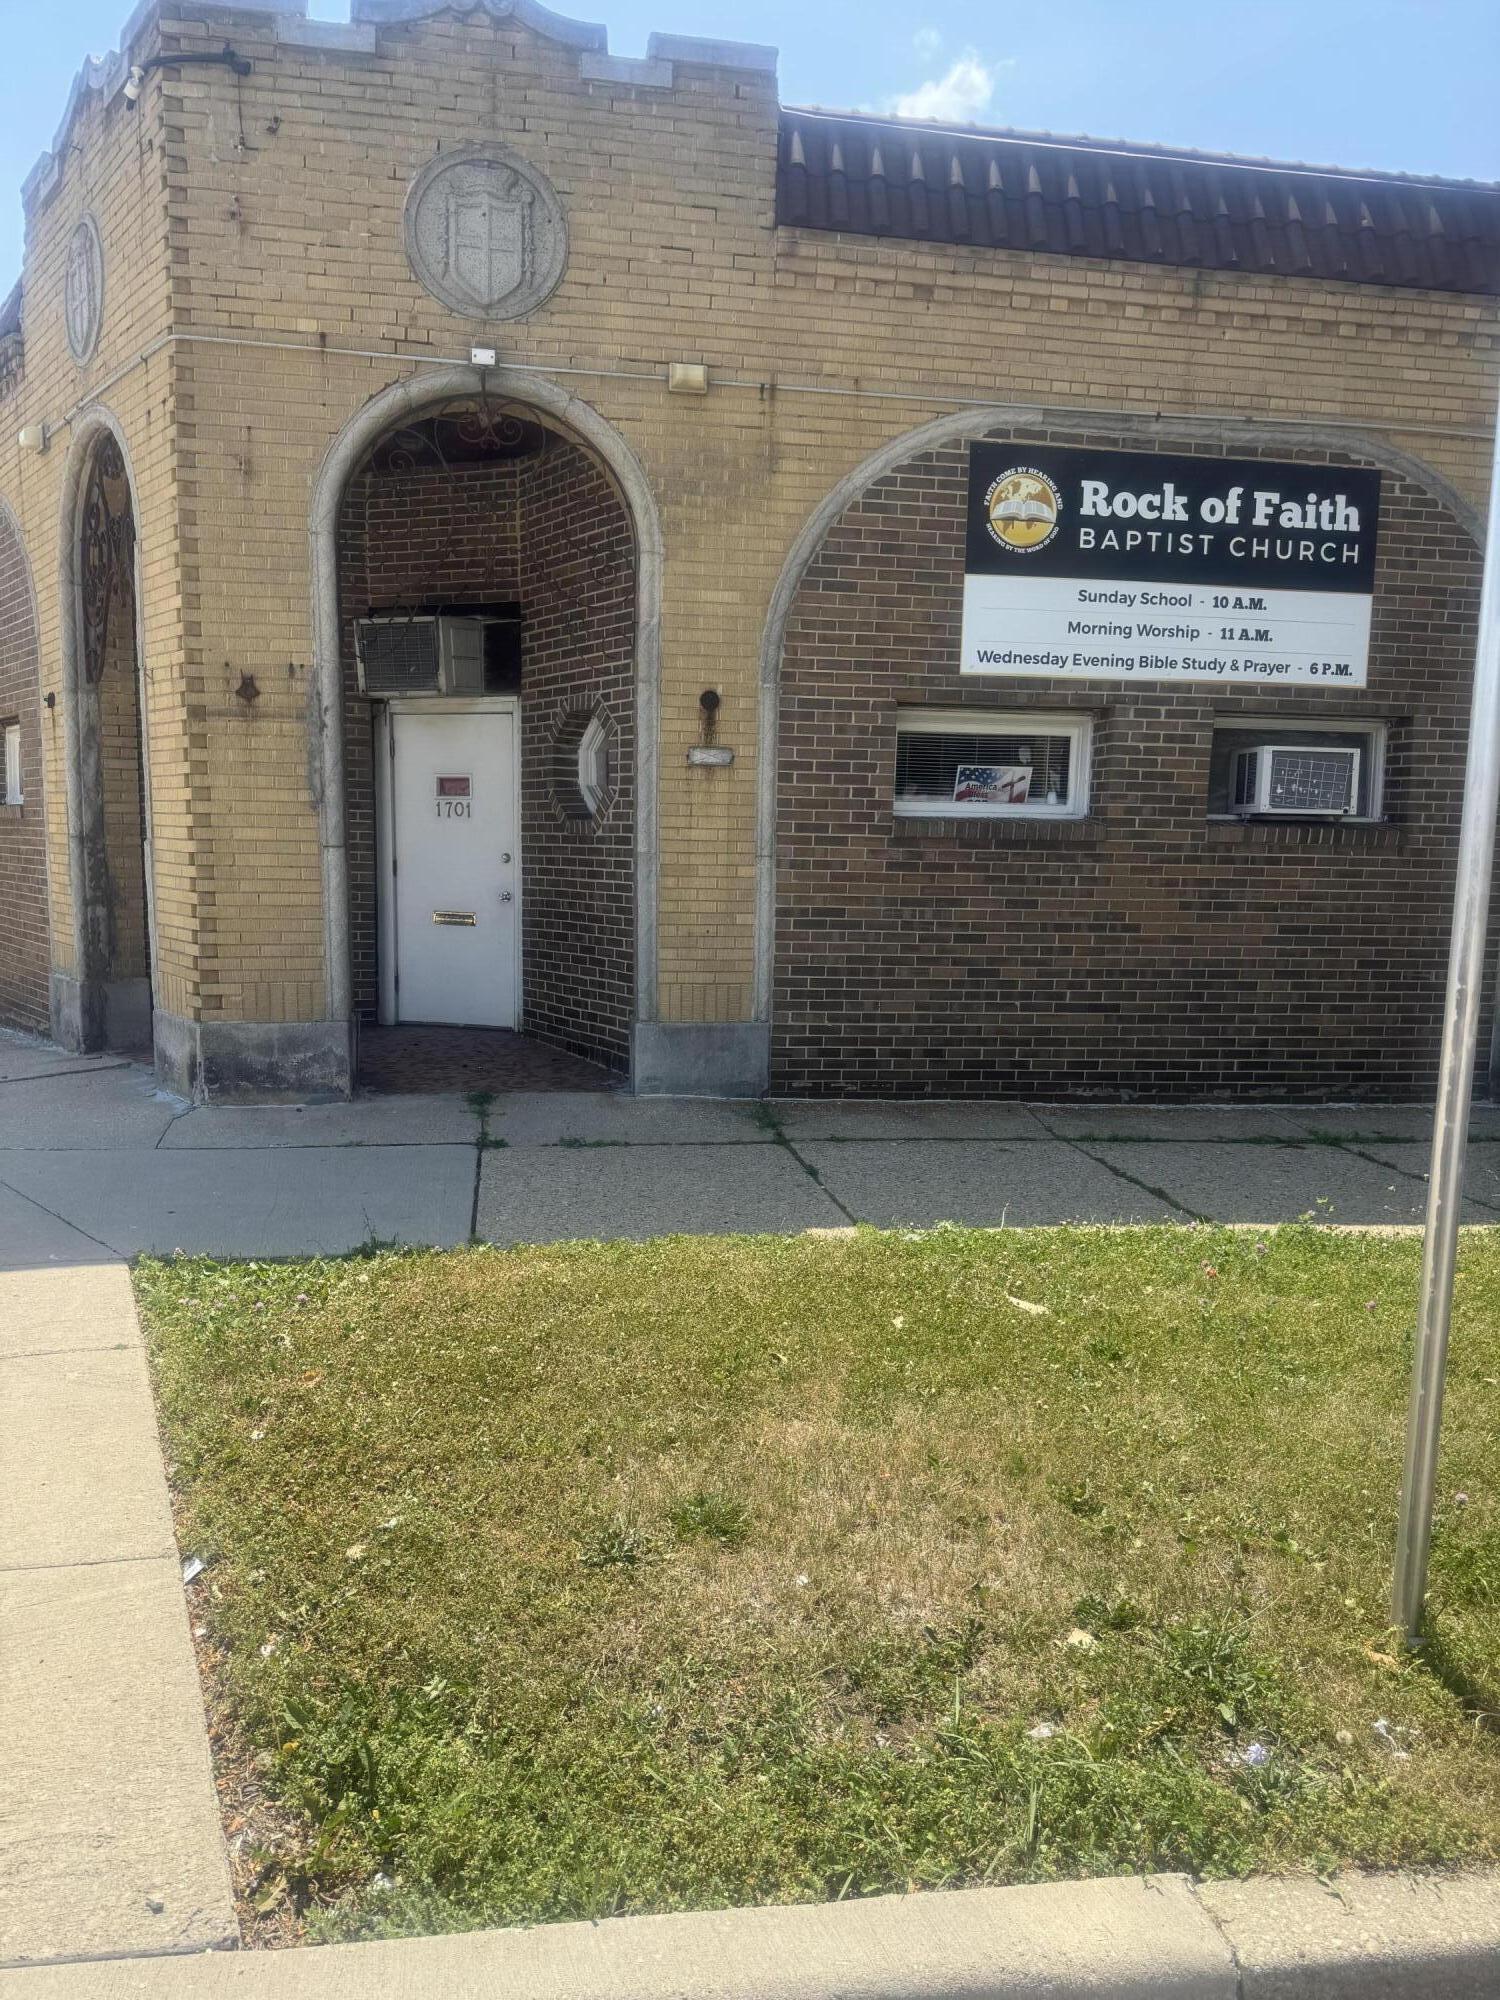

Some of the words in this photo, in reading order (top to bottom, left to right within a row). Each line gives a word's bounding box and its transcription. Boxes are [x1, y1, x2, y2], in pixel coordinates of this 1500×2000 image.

[984, 482, 997, 506] FAITH
[996, 468, 1016, 482] COME
[1028, 467, 1057, 492] HEARING
[1054, 492, 1063, 510] AND
[1079, 480, 1188, 521] Rock
[1200, 486, 1244, 524] of
[1252, 491, 1360, 532] Faith
[986, 523, 1005, 547] HEARING
[1005, 543, 1013, 551] BY
[1026, 543, 1044, 553] WORD
[1050, 526, 1059, 538] GOD
[1079, 527, 1214, 555] BAPTIST
[1229, 536, 1359, 564] CHURCH
[1078, 589, 1137, 607] Sunday
[1140, 592, 1192, 606] School
[1212, 596, 1229, 608] 10
[1232, 596, 1267, 610] A.M.
[1067, 621, 1132, 639] Morning
[1136, 623, 1200, 641] Worship
[1220, 627, 1234, 641] 11
[1238, 628, 1273, 642] A.M.
[977, 649, 1069, 668] Wednesday
[1072, 653, 1134, 670] Evening
[1139, 655, 1178, 669] Bible
[1181, 656, 1226, 673] Study
[1230, 659, 1239, 672] &
[1243, 659, 1291, 676] Prayer
[1309, 662, 1319, 675] 6
[1322, 663, 1353, 676] P.M.
[965, 782, 998, 791] America
[436, 801, 471, 818] 1701
